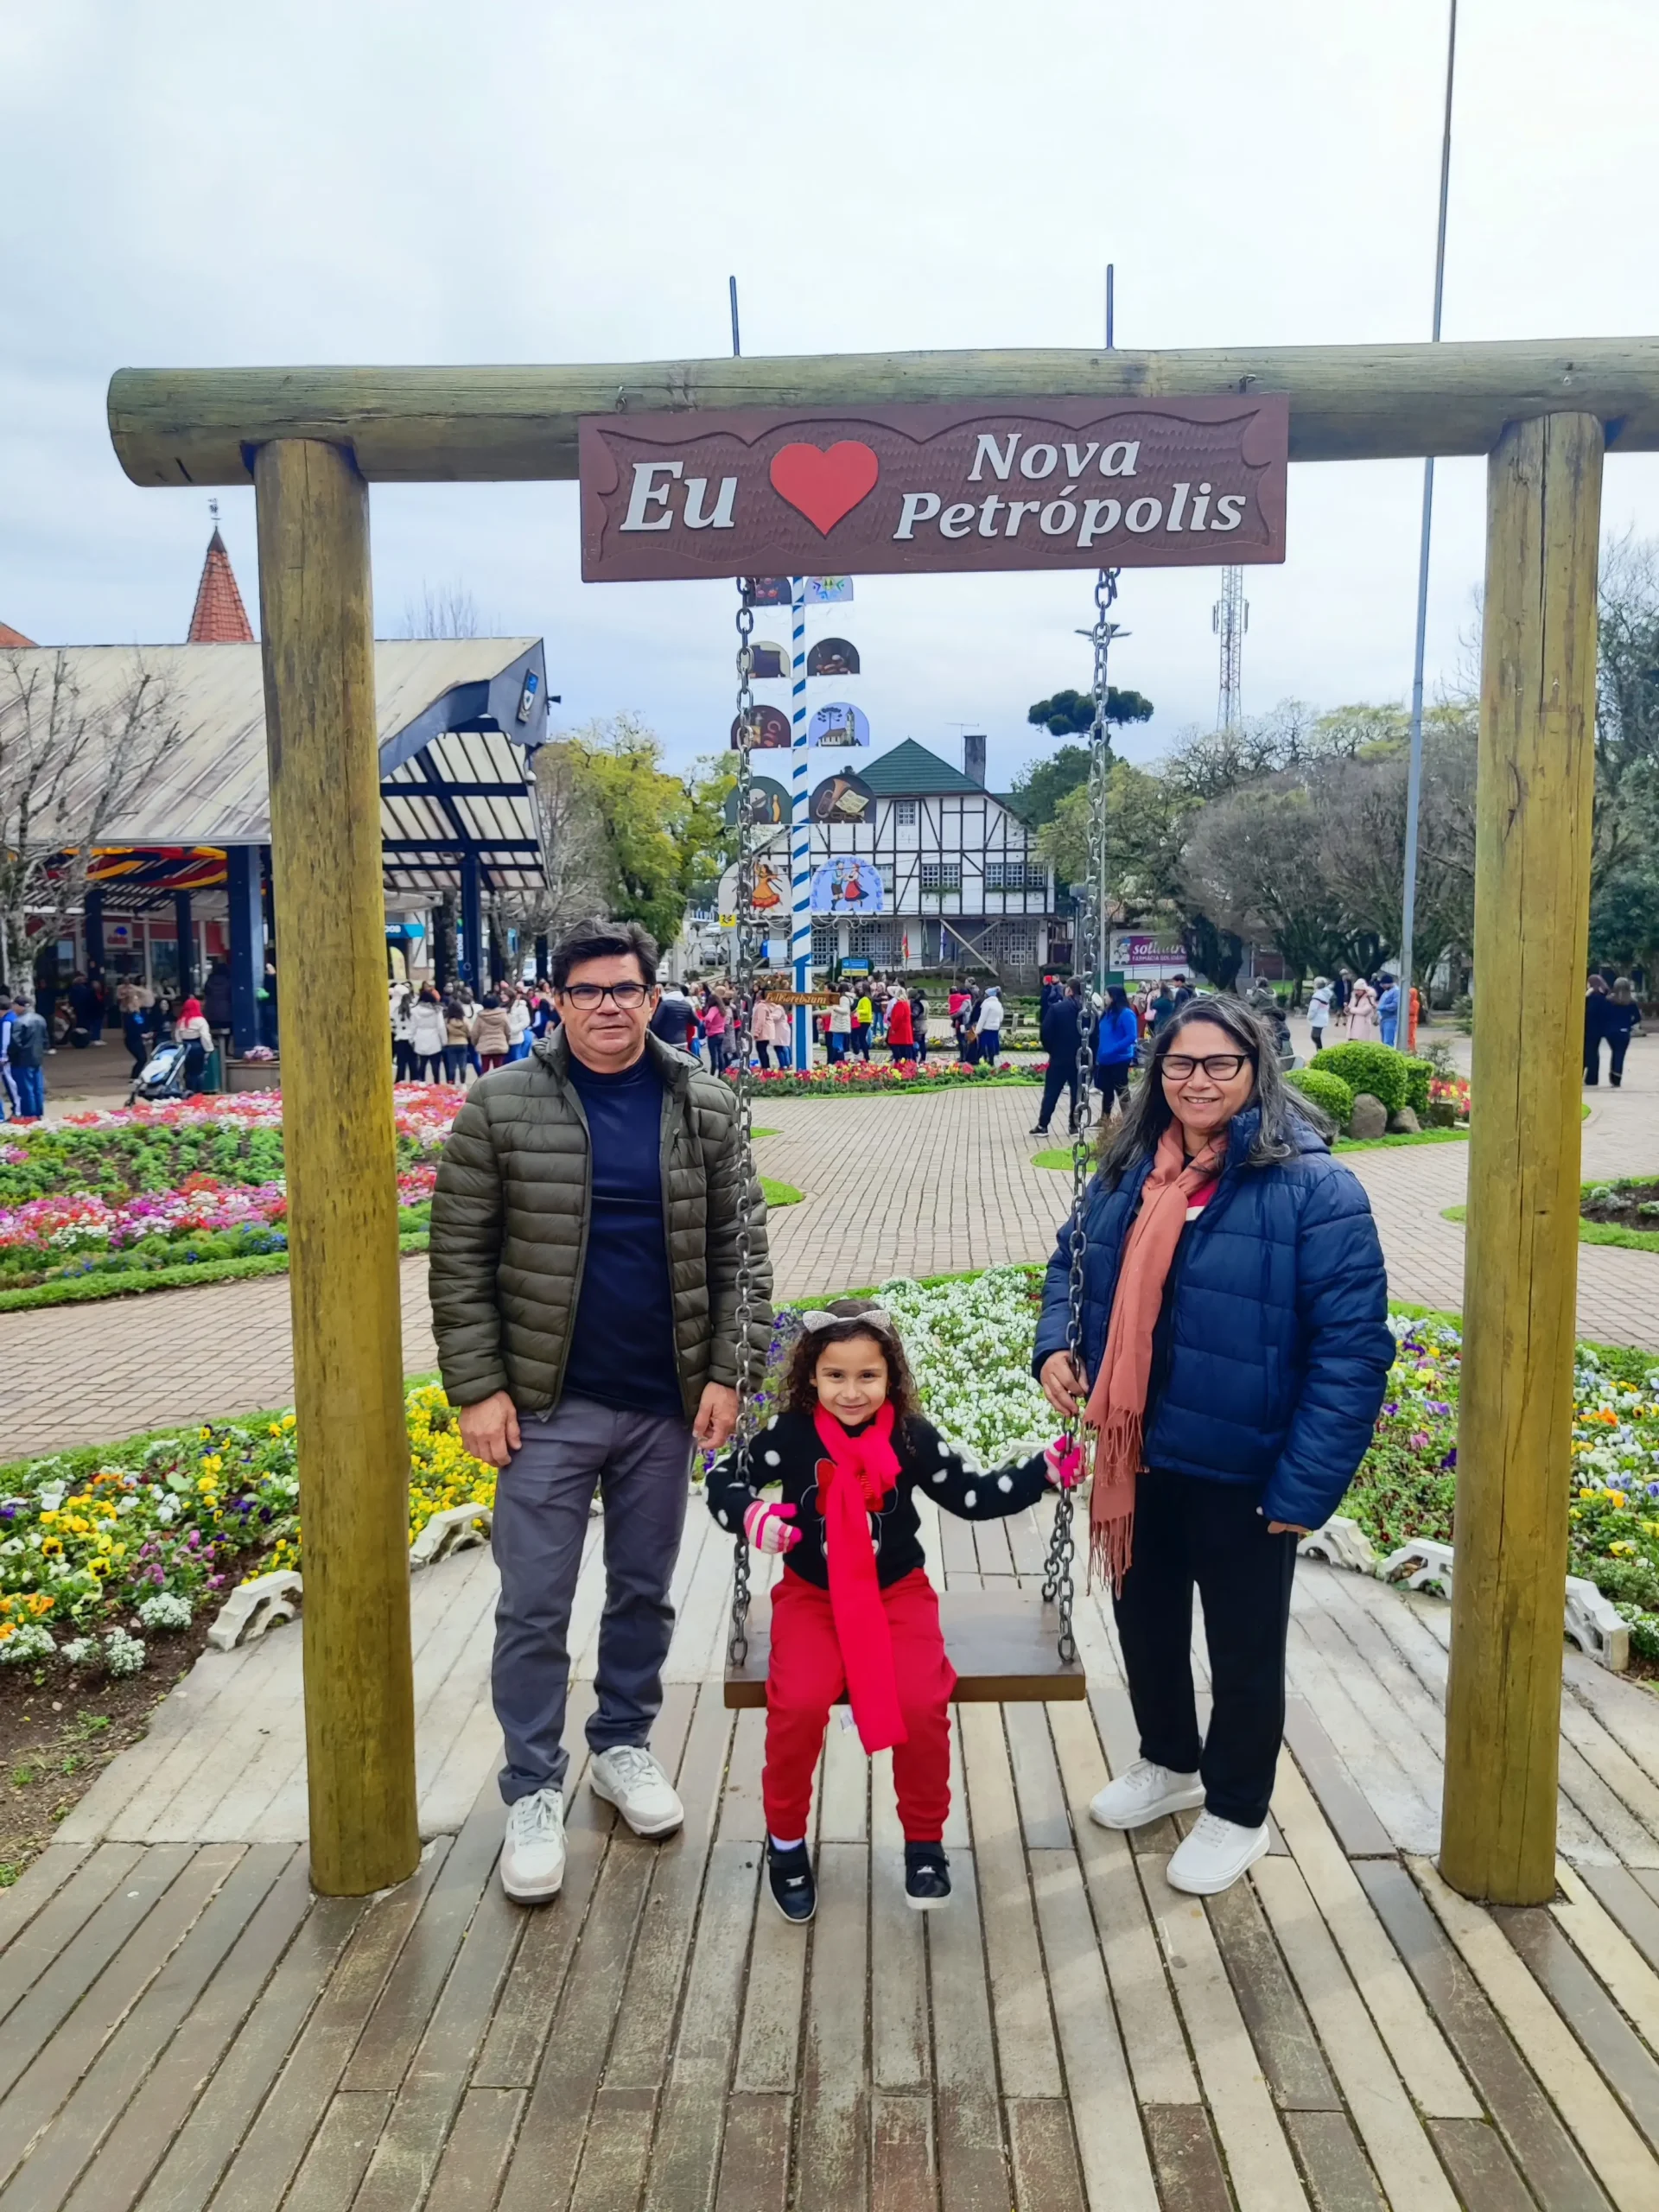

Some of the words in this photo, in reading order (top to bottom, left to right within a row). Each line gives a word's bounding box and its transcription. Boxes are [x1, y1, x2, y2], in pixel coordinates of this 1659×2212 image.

[967, 433, 1141, 480] Nova
[619, 461, 738, 531] Eu
[893, 482, 1247, 548] Petrópolis
